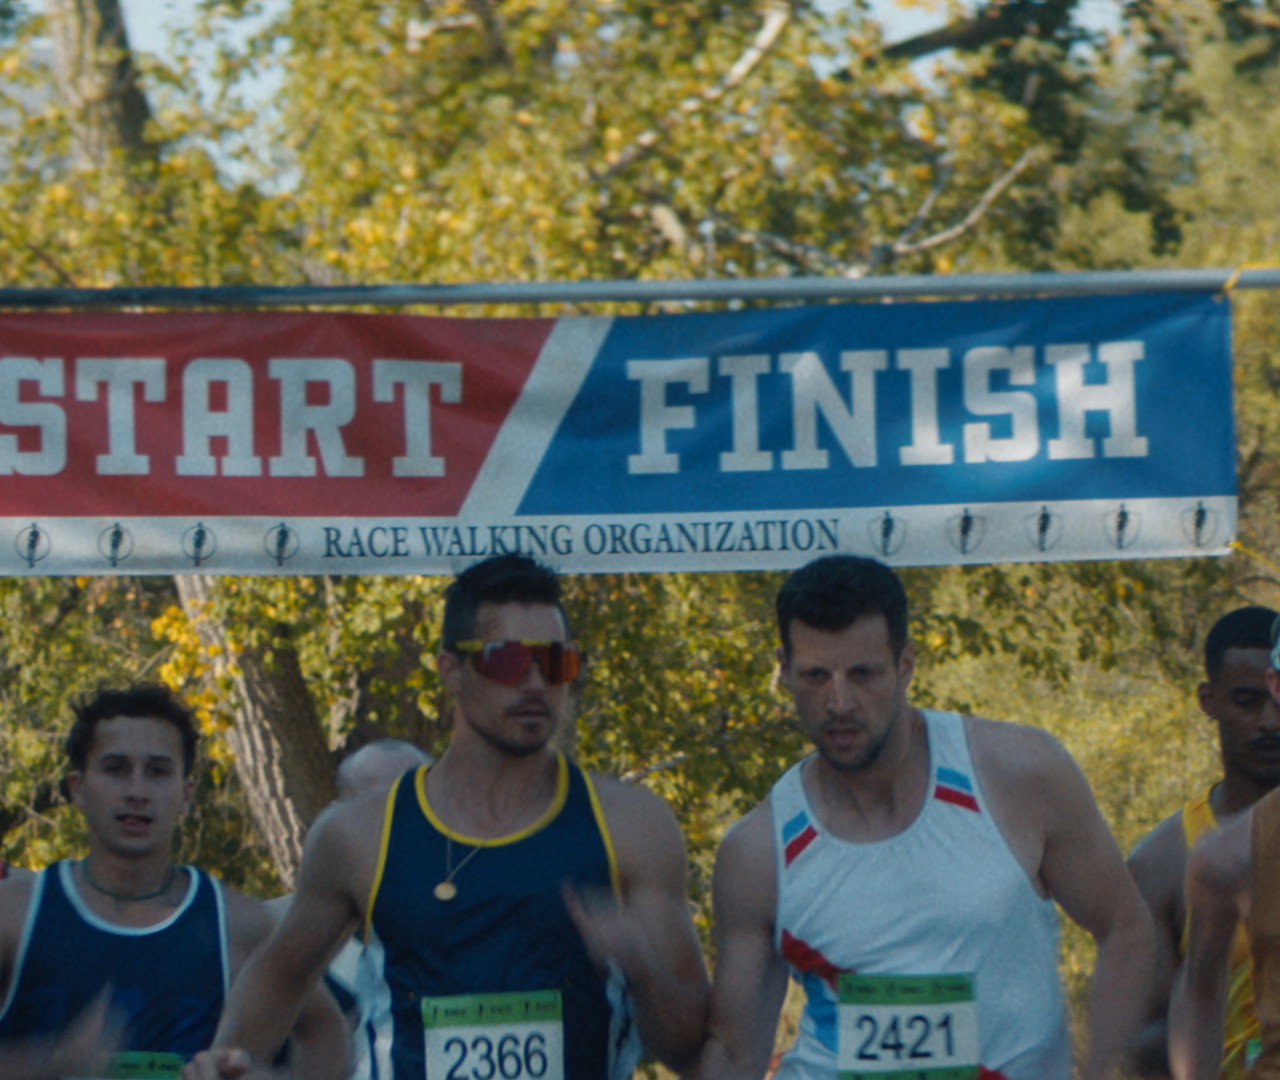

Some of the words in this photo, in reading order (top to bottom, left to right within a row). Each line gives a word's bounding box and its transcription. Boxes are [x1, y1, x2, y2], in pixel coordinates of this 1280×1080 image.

[627, 341, 1149, 475] FINISH
[323, 526, 409, 559] RACE
[419, 524, 573, 558] WALKING
[583, 518, 840, 556] ORGANIZATION
[856, 1012, 955, 1060] 2421
